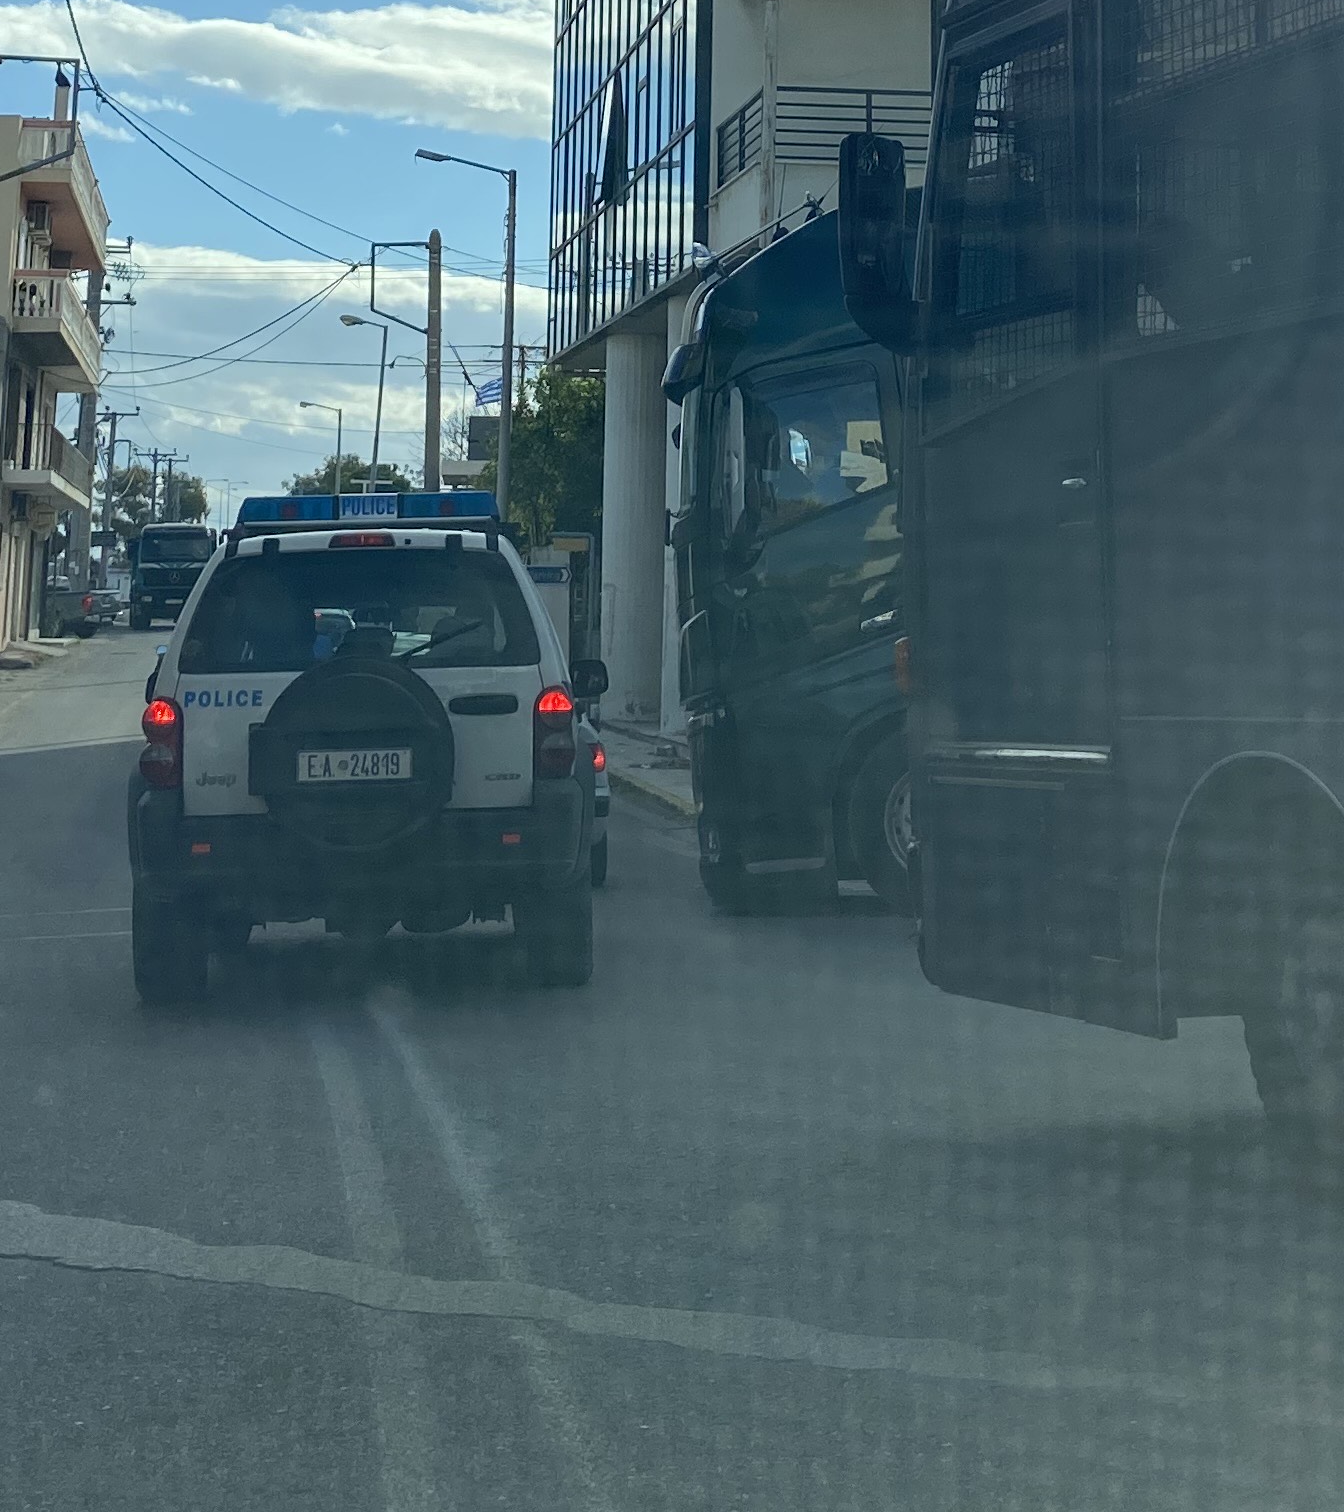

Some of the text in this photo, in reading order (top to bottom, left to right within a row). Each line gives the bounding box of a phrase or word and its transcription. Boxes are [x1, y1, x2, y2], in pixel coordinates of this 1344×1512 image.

[342, 496, 395, 516] POLICE
[184, 690, 263, 707] POLICE
[350, 752, 400, 777] 24819
[196, 771, 236, 787] Jeep
